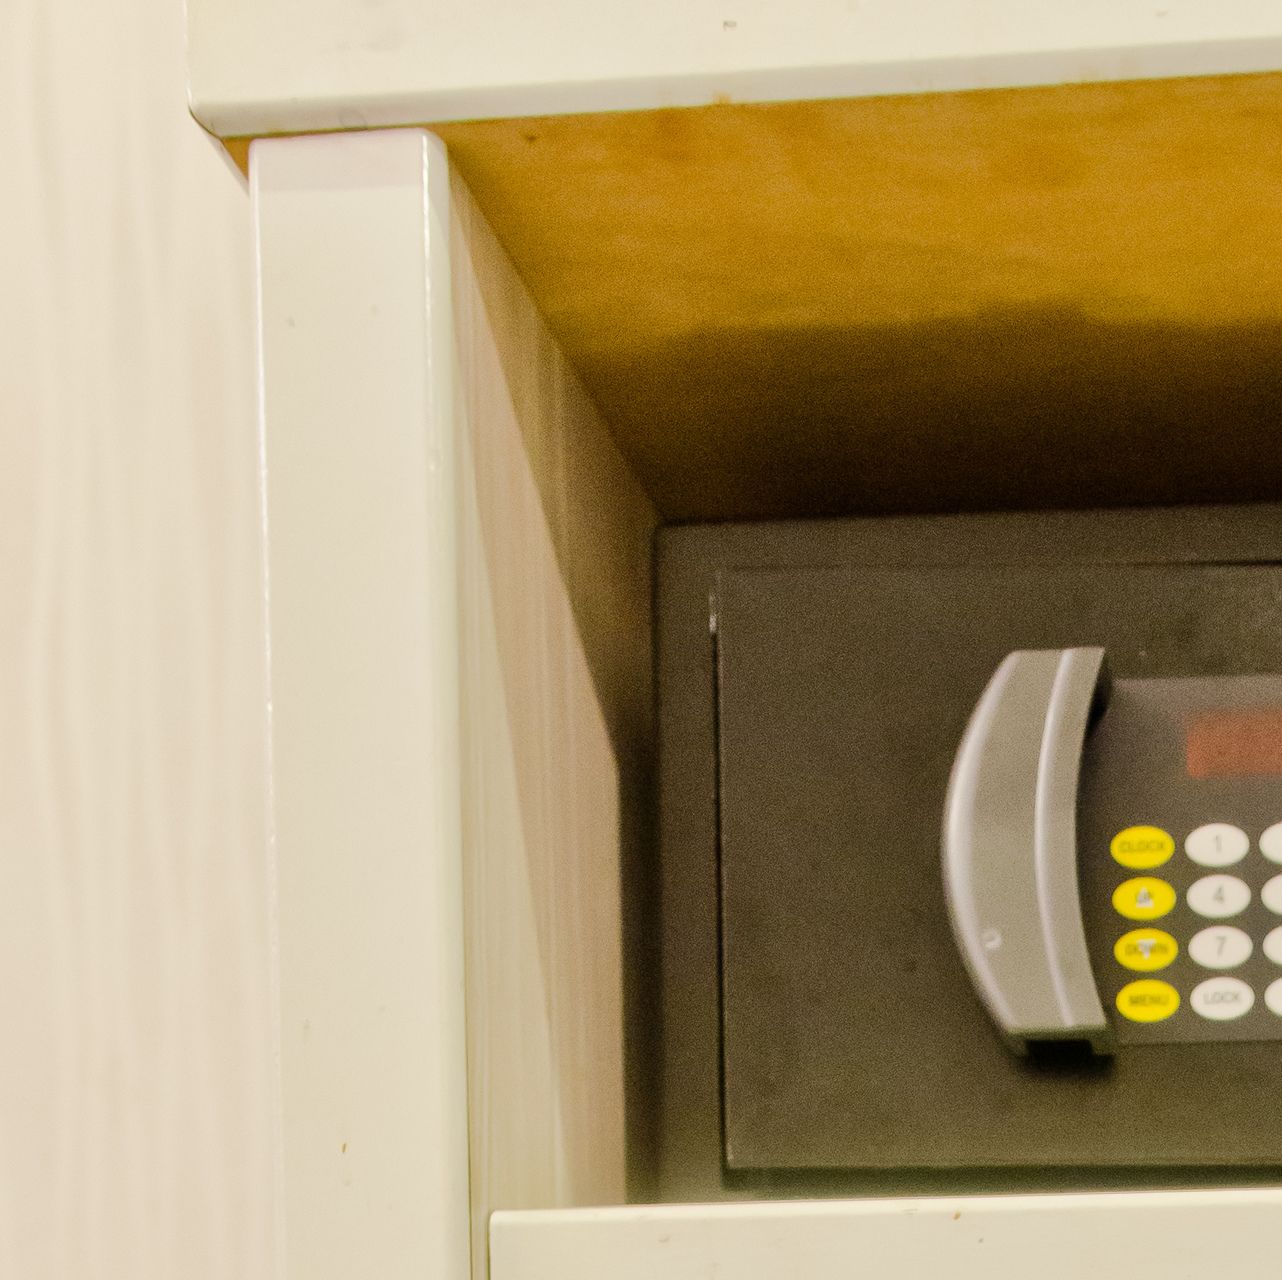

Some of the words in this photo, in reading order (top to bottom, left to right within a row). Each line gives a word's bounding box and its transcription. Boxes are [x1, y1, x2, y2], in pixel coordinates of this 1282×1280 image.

[1118, 838, 1166, 853] CLOCK
[1213, 834, 1223, 852] 1
[1212, 885, 1225, 904] 4
[1214, 935, 1228, 957] 7
[1128, 993, 1170, 1008] MENU
[1202, 990, 1242, 1006] LOCK
